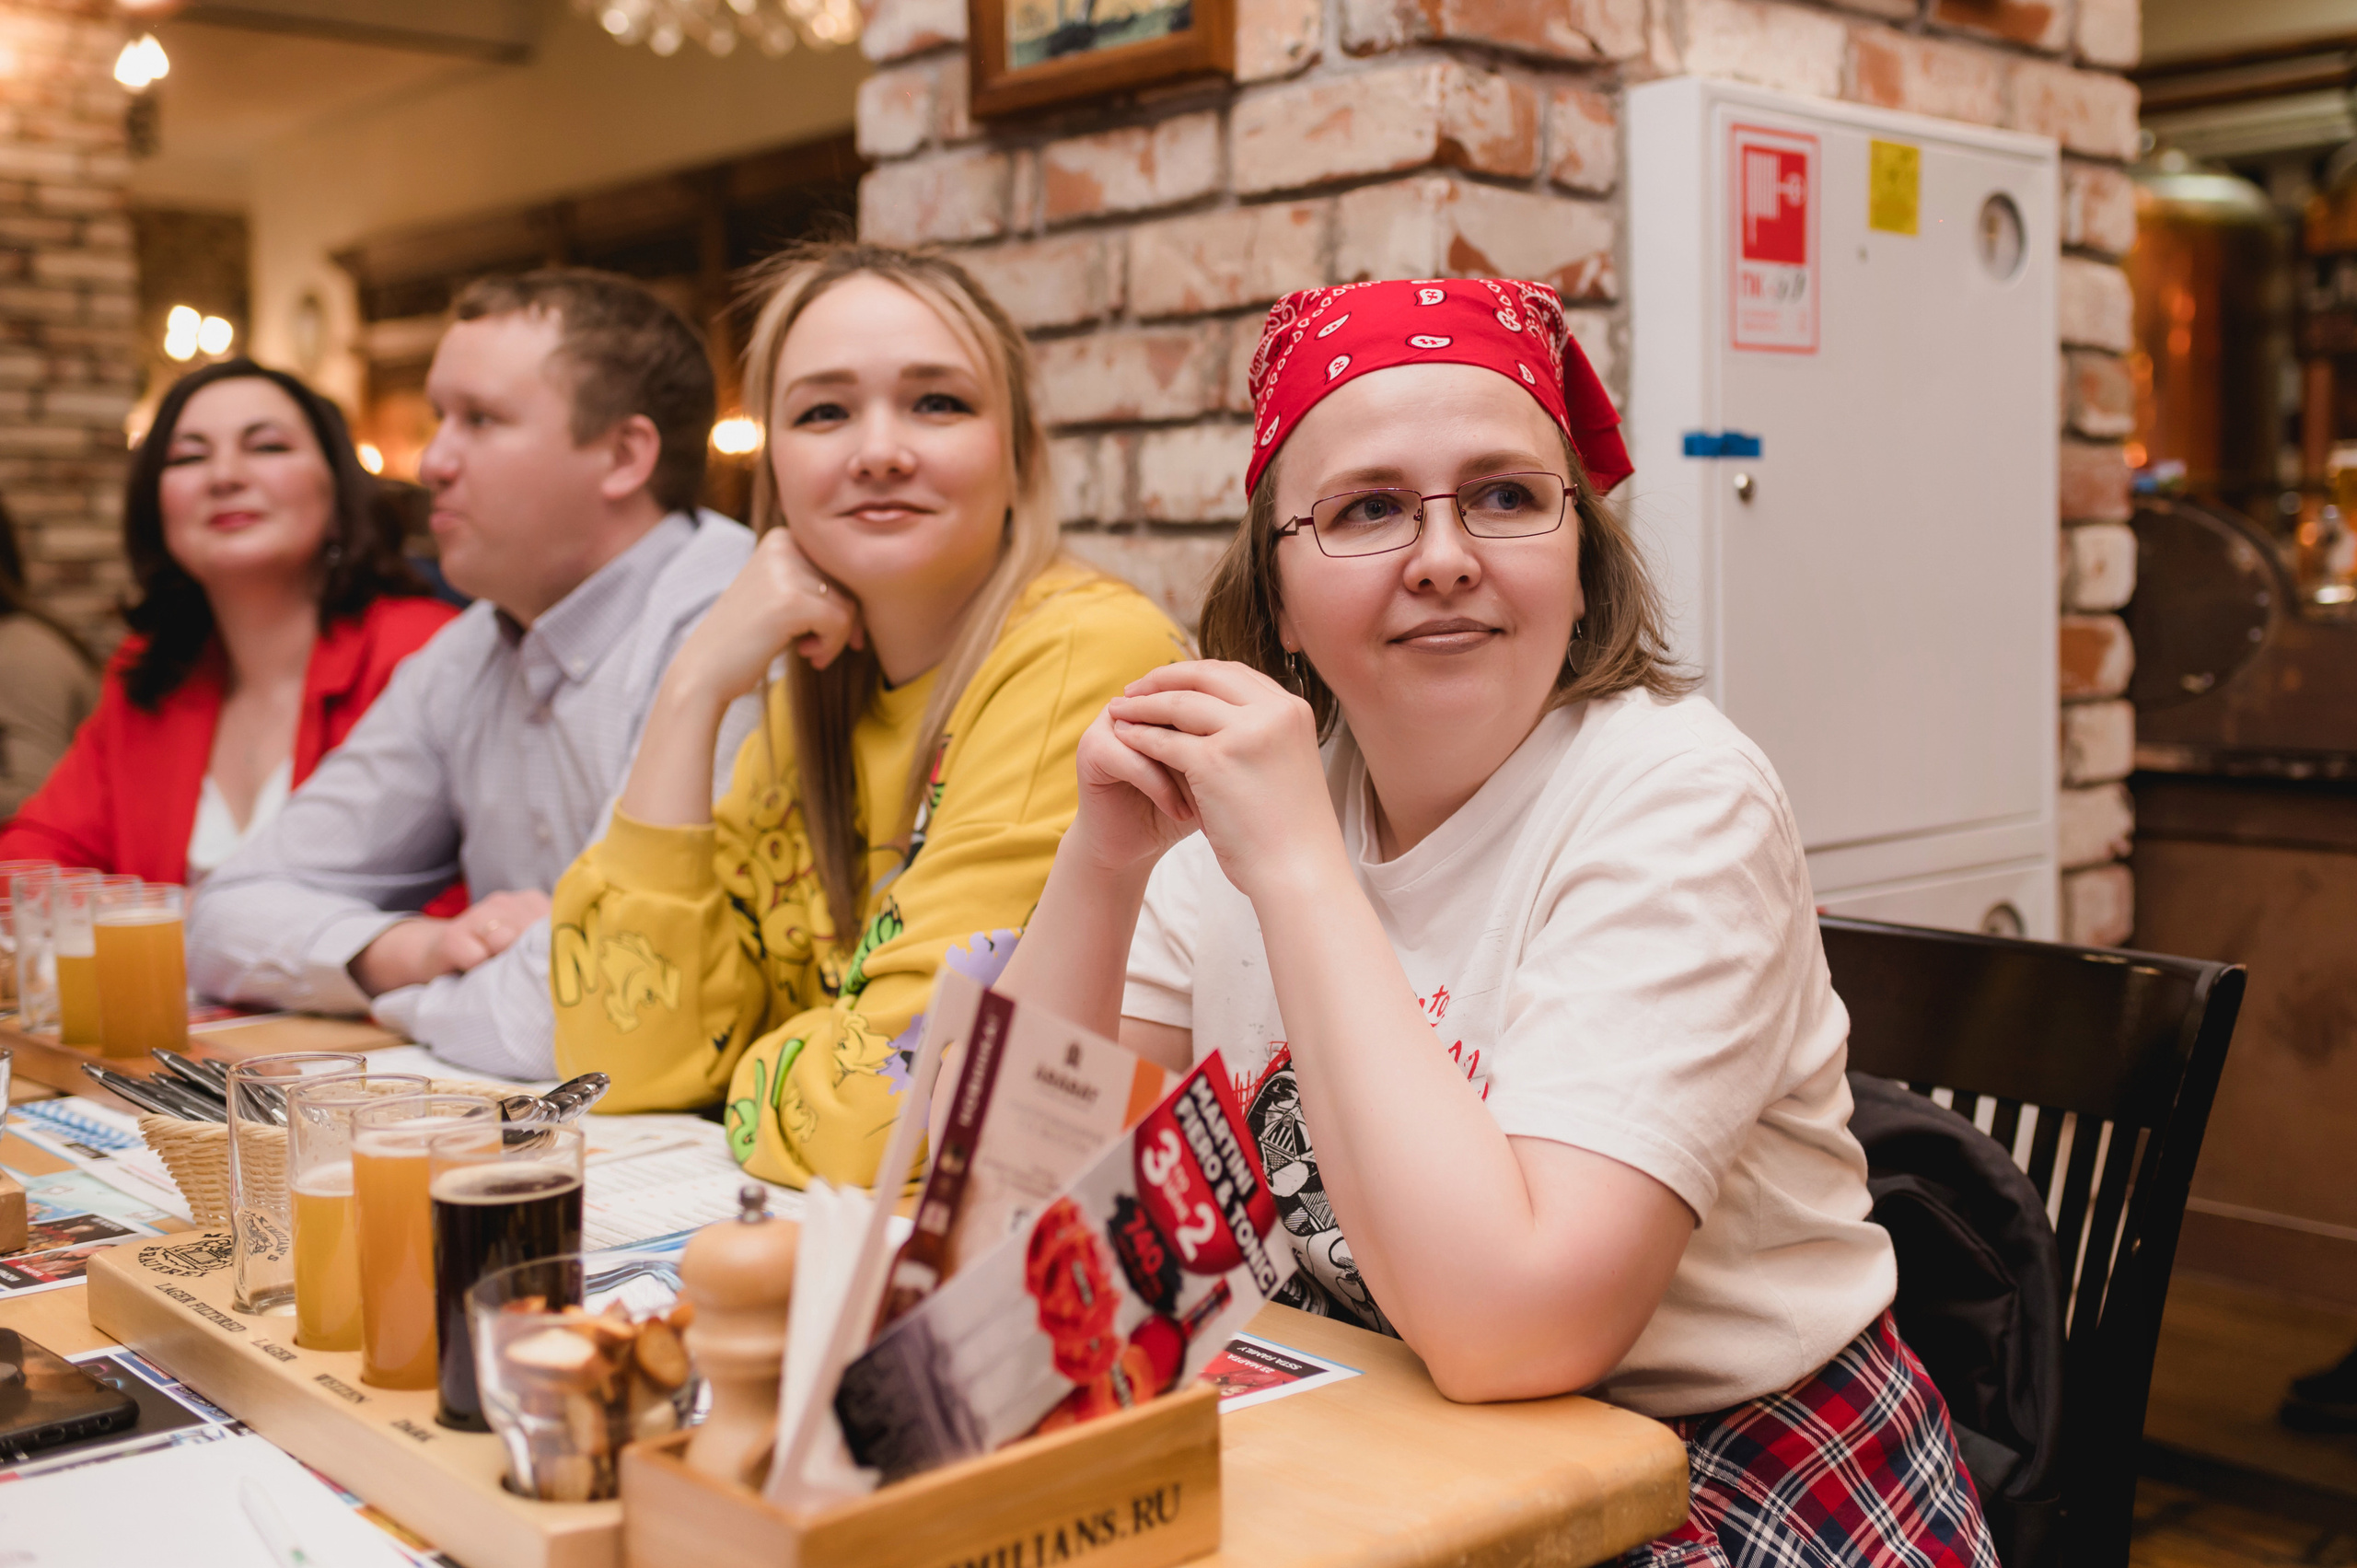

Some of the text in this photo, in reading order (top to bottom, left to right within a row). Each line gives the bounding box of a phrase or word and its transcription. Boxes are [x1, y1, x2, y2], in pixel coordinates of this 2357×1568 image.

[1190, 1073, 1256, 1197] MARTINI
[1142, 1128, 1182, 1186] 3
[1175, 1202, 1217, 1263] 2
[1174, 1094, 1278, 1291] FIERO & TONIC
[155, 1283, 247, 1332] LAGER FILTERED
[250, 1338, 297, 1363] LAGER
[1226, 1353, 1263, 1371] МАРТА
[1237, 1345, 1277, 1362] FAMILY
